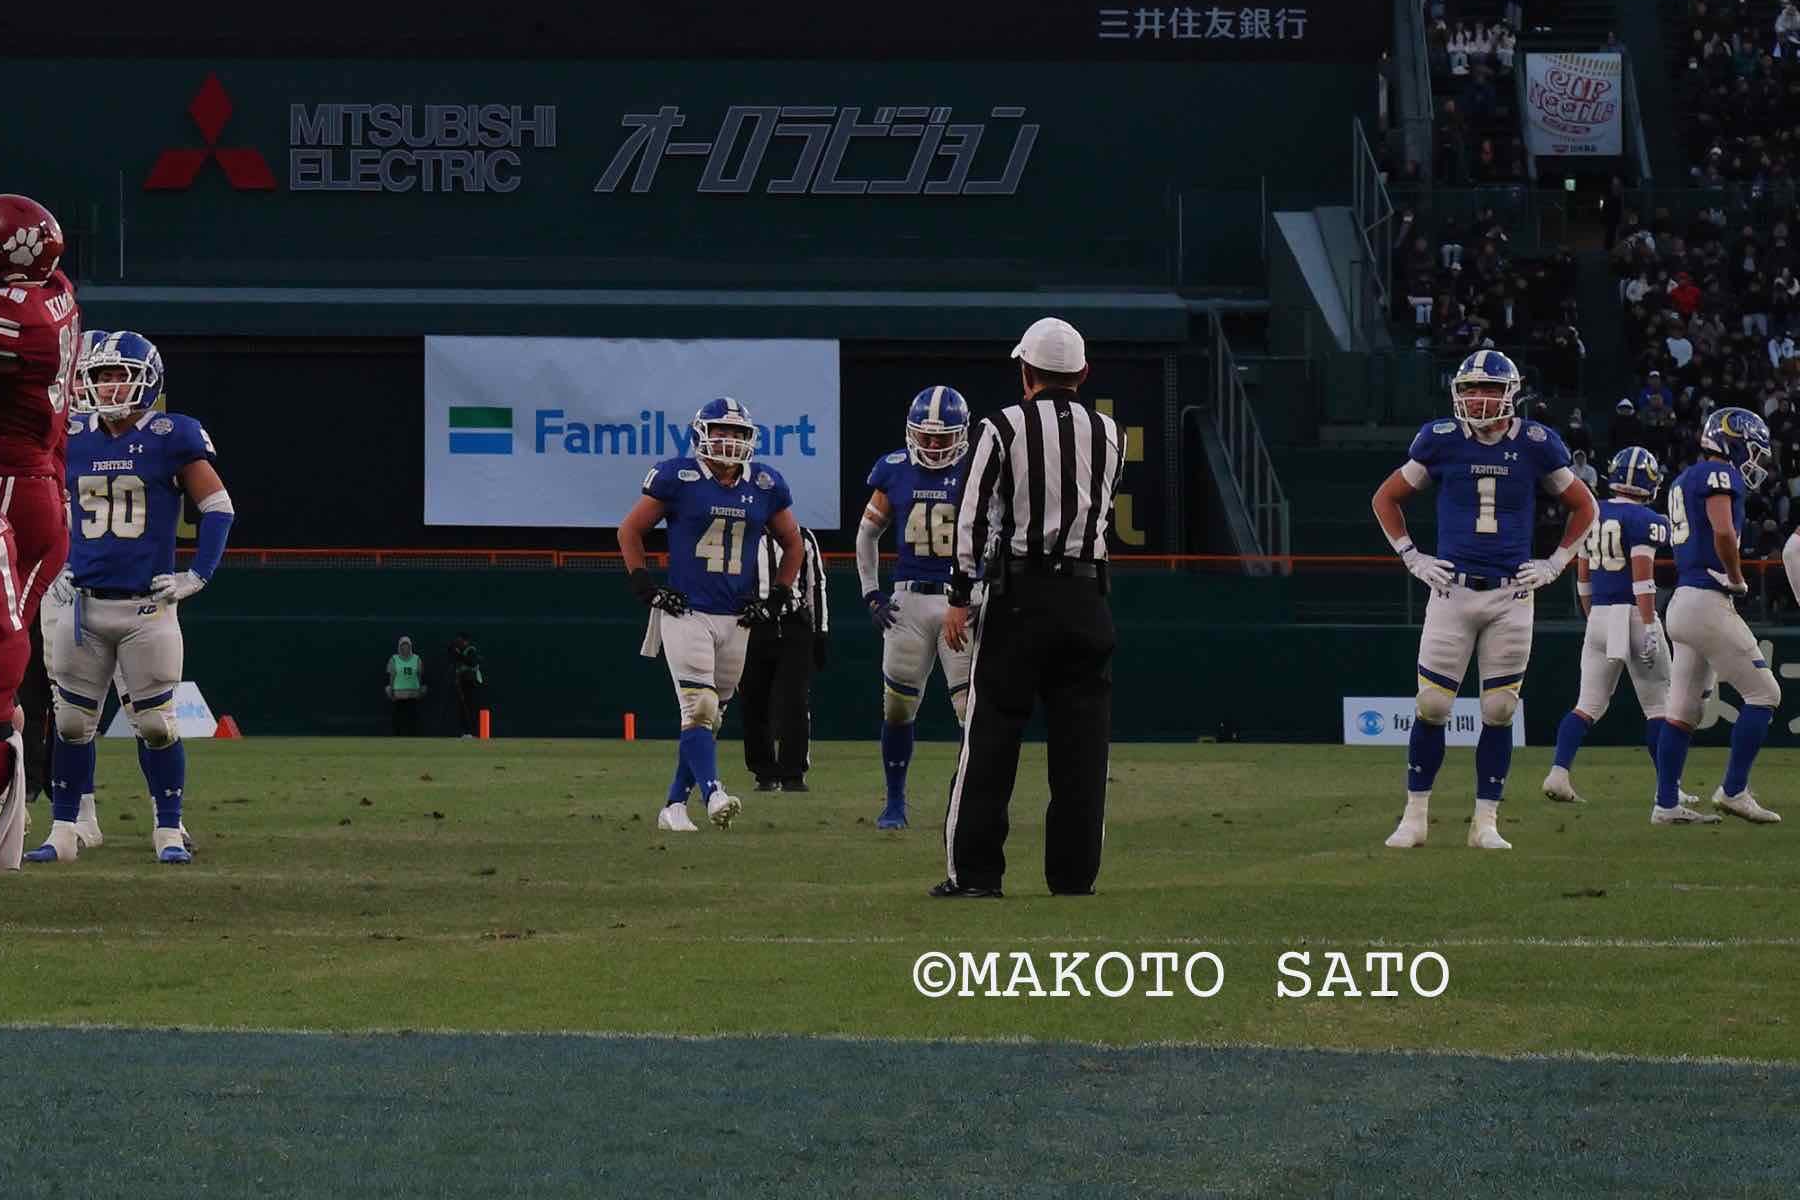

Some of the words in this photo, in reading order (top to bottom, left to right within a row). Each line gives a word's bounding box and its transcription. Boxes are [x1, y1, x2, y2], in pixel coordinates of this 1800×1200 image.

[1098, 7, 1308, 39] 三井住友銀行
[290, 104, 556, 147] MITSUBISHI
[290, 150, 521, 191] ELECTRIC
[594, 106, 1040, 193] オーロラビジョン
[535, 409, 816, 457] Familyart
[92, 460, 133, 472] FIGHTERS
[1707, 472, 1731, 489] 49
[78, 475, 146, 539] 50
[1475, 477, 1498, 533] 1
[695, 518, 746, 575] 41
[905, 502, 954, 557] 46
[1649, 523, 1666, 542] 30
